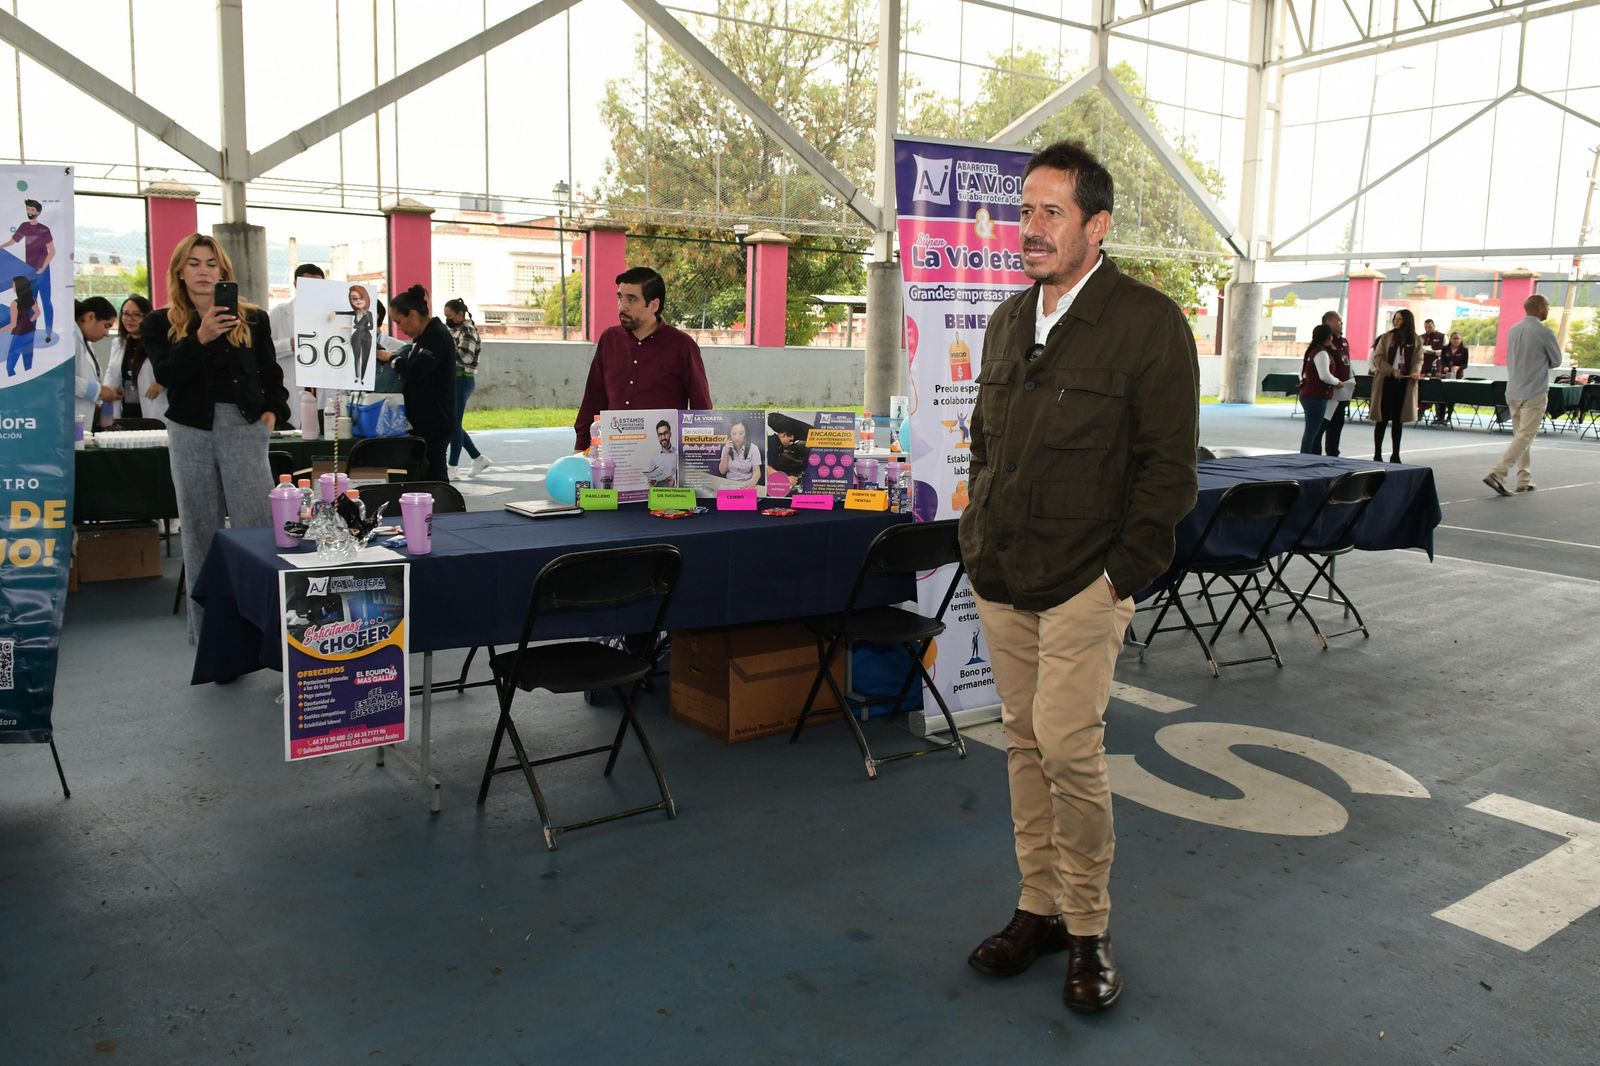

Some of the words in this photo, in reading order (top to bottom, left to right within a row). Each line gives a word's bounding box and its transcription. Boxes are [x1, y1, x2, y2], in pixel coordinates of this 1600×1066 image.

[956, 162, 998, 173] ABARROTES
[957, 173, 981, 192] LA
[958, 192, 967, 201] su
[969, 193, 1010, 204] abarrotera
[1011, 196, 1021, 204] de
[912, 246, 941, 269] La
[945, 247, 1024, 271] Violeta
[909, 285, 955, 301] Grandes
[957, 288, 1003, 304] empresas
[945, 313, 989, 329] BENE
[296, 331, 346, 367] 56
[935, 384, 959, 393] Precio
[960, 385, 981, 395] espe
[947, 454, 972, 463] Estabil
[0, 478, 39, 490] TRO
[9, 500, 66, 529] DE
[331, 579, 342, 590] LA
[346, 577, 386, 590] VIOLETA
[951, 600, 976, 611] termin
[304, 618, 362, 646] Solicitamos
[319, 625, 390, 655] CHOFER
[297, 666, 345, 679] OFRECEMOS
[365, 668, 389, 678] EQUIPO
[372, 674, 394, 683] GALLO
[960, 667, 980, 678] Bono
[981, 666, 991, 676] po
[355, 691, 398, 710] ESTAMOS
[350, 698, 402, 720] BUSCANDO!
